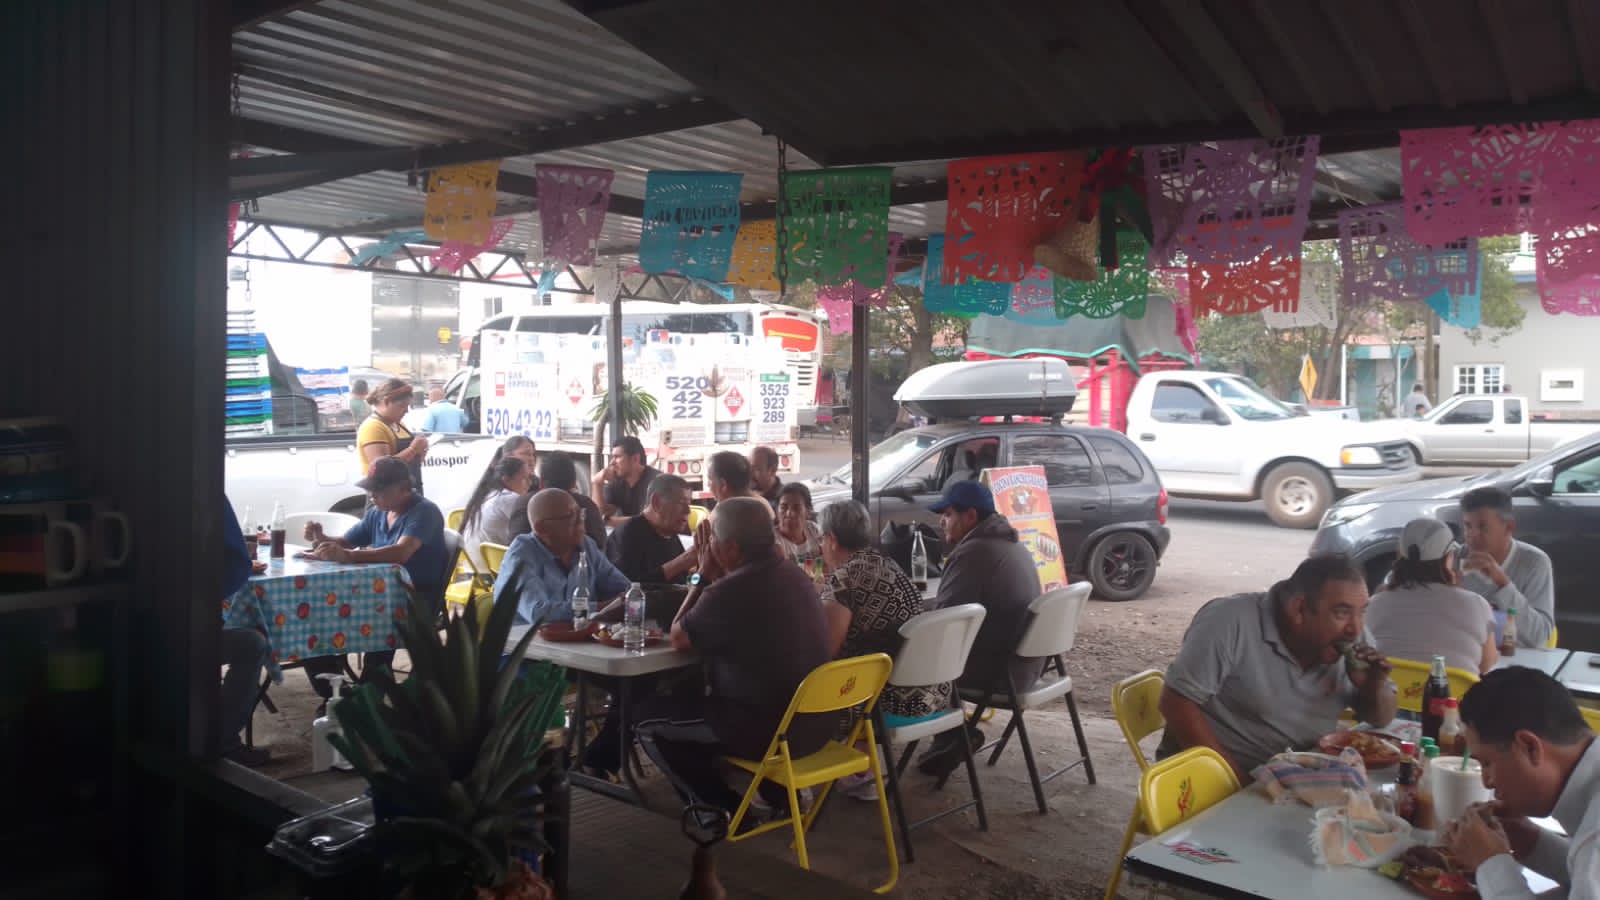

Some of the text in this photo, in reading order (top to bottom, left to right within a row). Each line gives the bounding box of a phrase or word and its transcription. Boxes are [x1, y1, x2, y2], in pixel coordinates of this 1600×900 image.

[665, 376, 709, 389] 520
[760, 384, 789, 396] 3525
[672, 391, 702, 404] 42
[763, 397, 785, 410] 923
[672, 405, 702, 419] 22
[763, 411, 785, 423] 289
